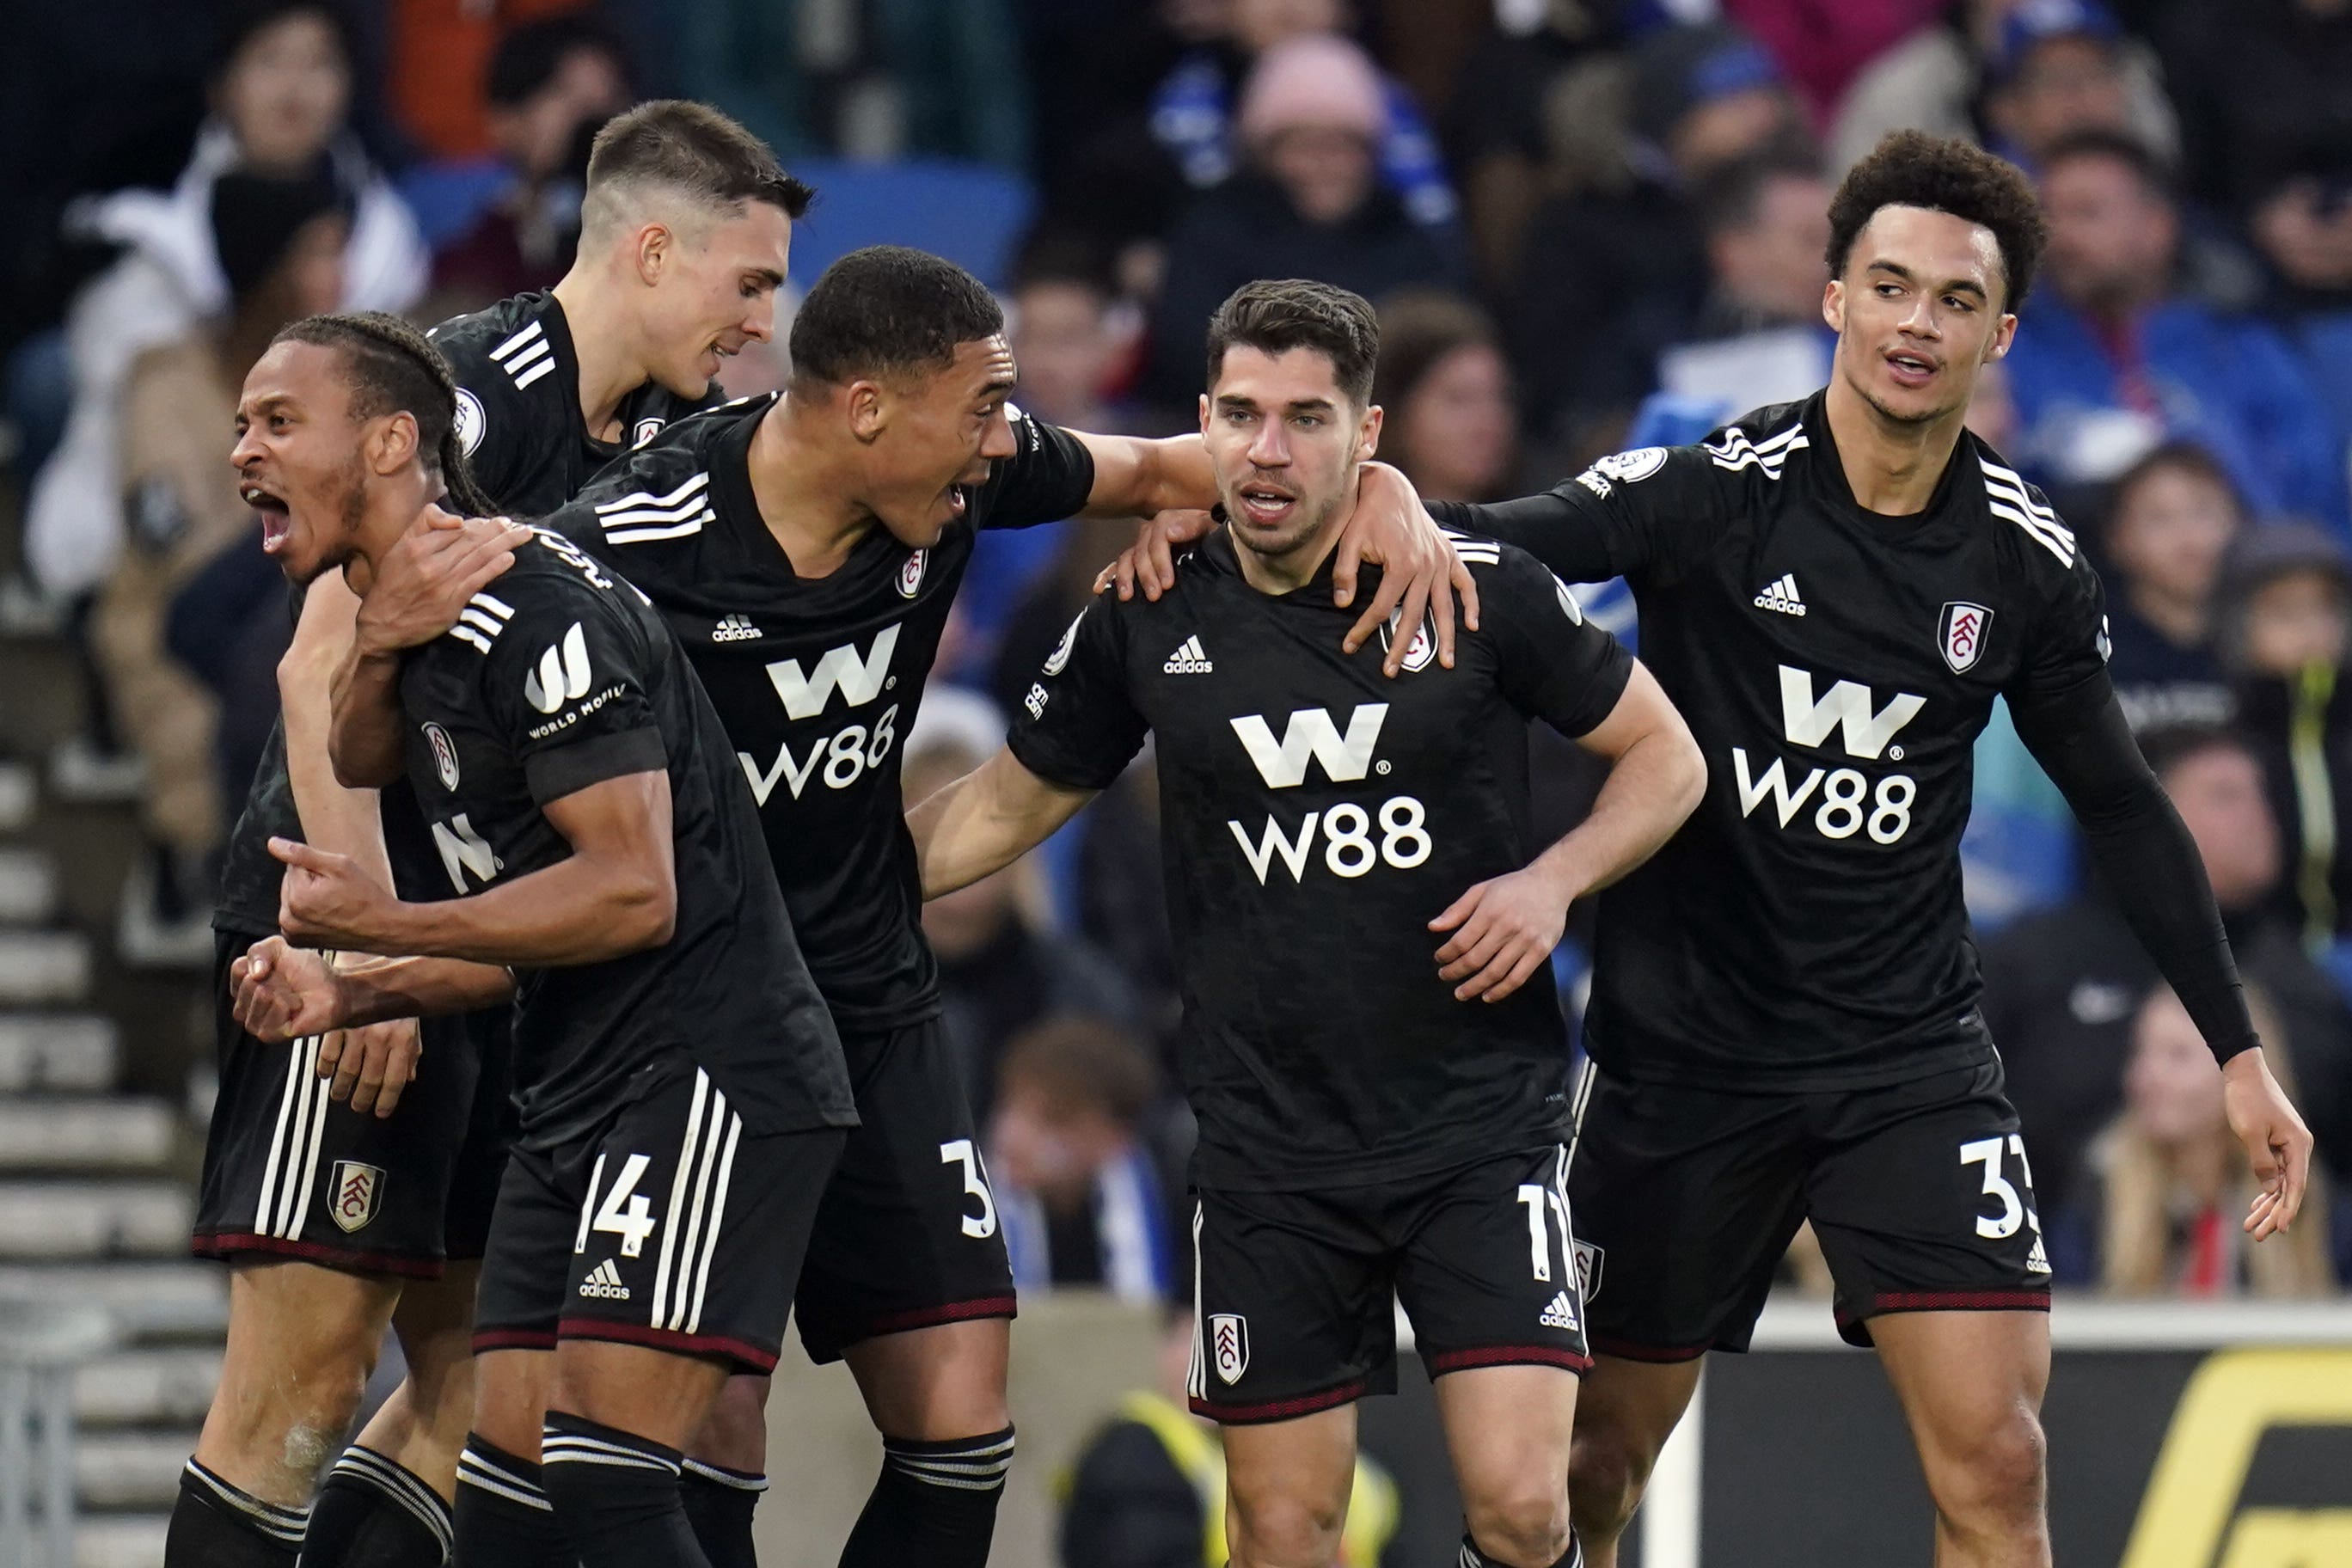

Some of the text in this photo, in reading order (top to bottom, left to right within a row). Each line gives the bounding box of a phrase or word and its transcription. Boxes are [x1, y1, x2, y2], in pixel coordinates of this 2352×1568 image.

[1754, 593, 1806, 616] adidas
[712, 627, 763, 642] adidas
[1163, 657, 1213, 674] adidas
[529, 712, 577, 739] WORLD
[737, 703, 899, 808] W88
[1732, 747, 1916, 844] W88
[1228, 796, 1432, 886] W88
[574, 1153, 656, 1258] 14
[1517, 1185, 1576, 1290] 11
[579, 1283, 629, 1299] adidas
